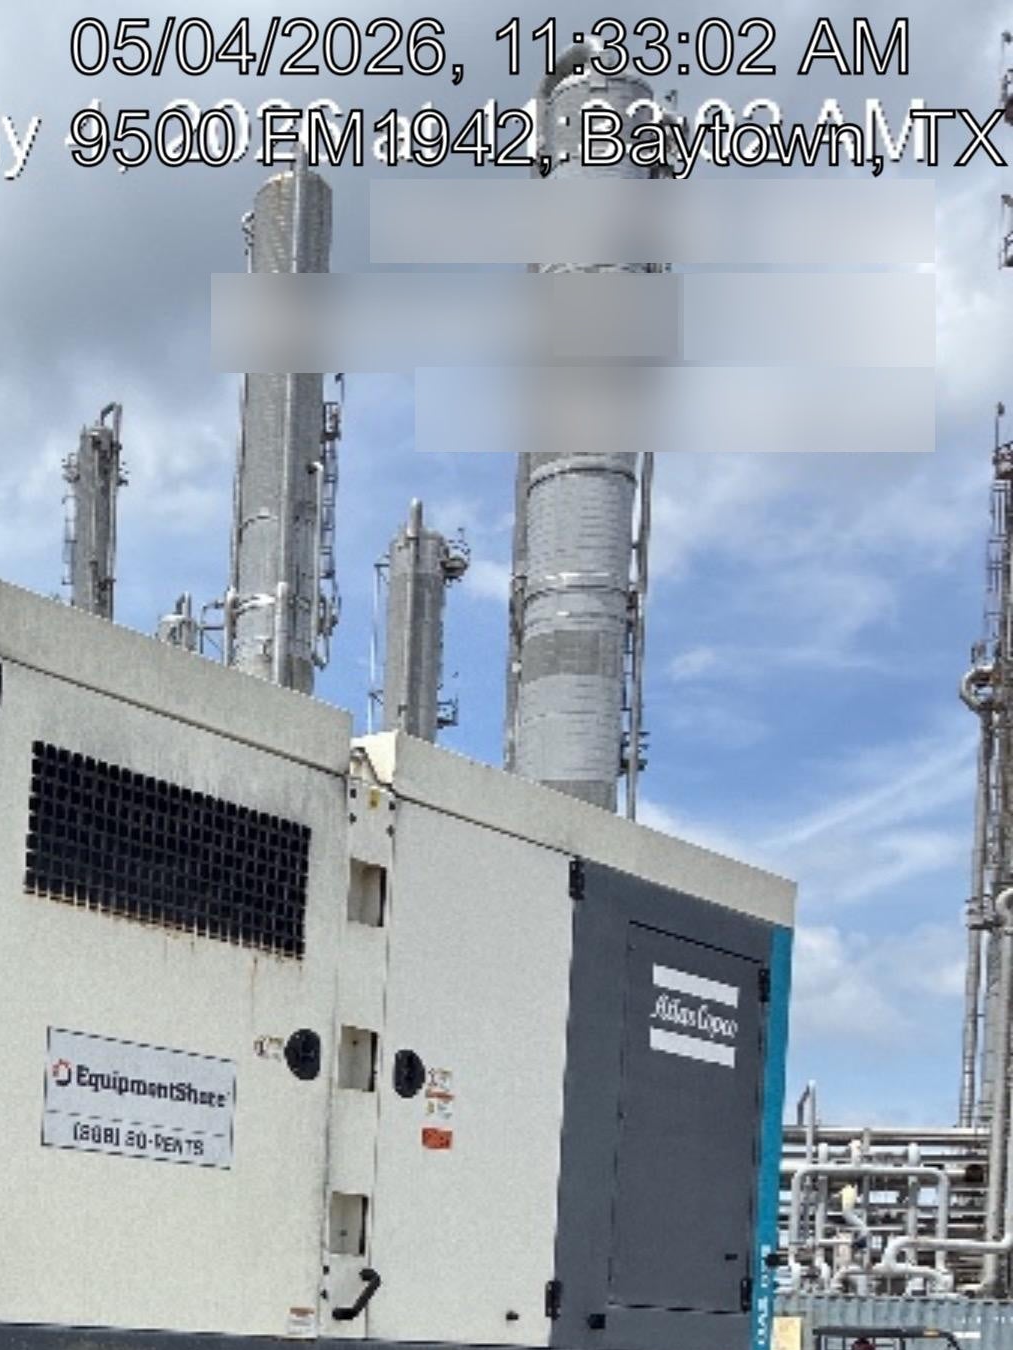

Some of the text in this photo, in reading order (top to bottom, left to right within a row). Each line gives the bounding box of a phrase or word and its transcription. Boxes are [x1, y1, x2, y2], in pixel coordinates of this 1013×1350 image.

[649, 993, 738, 1039] Atlas Copco
[76, 1063, 226, 1108] EquipmentShare
